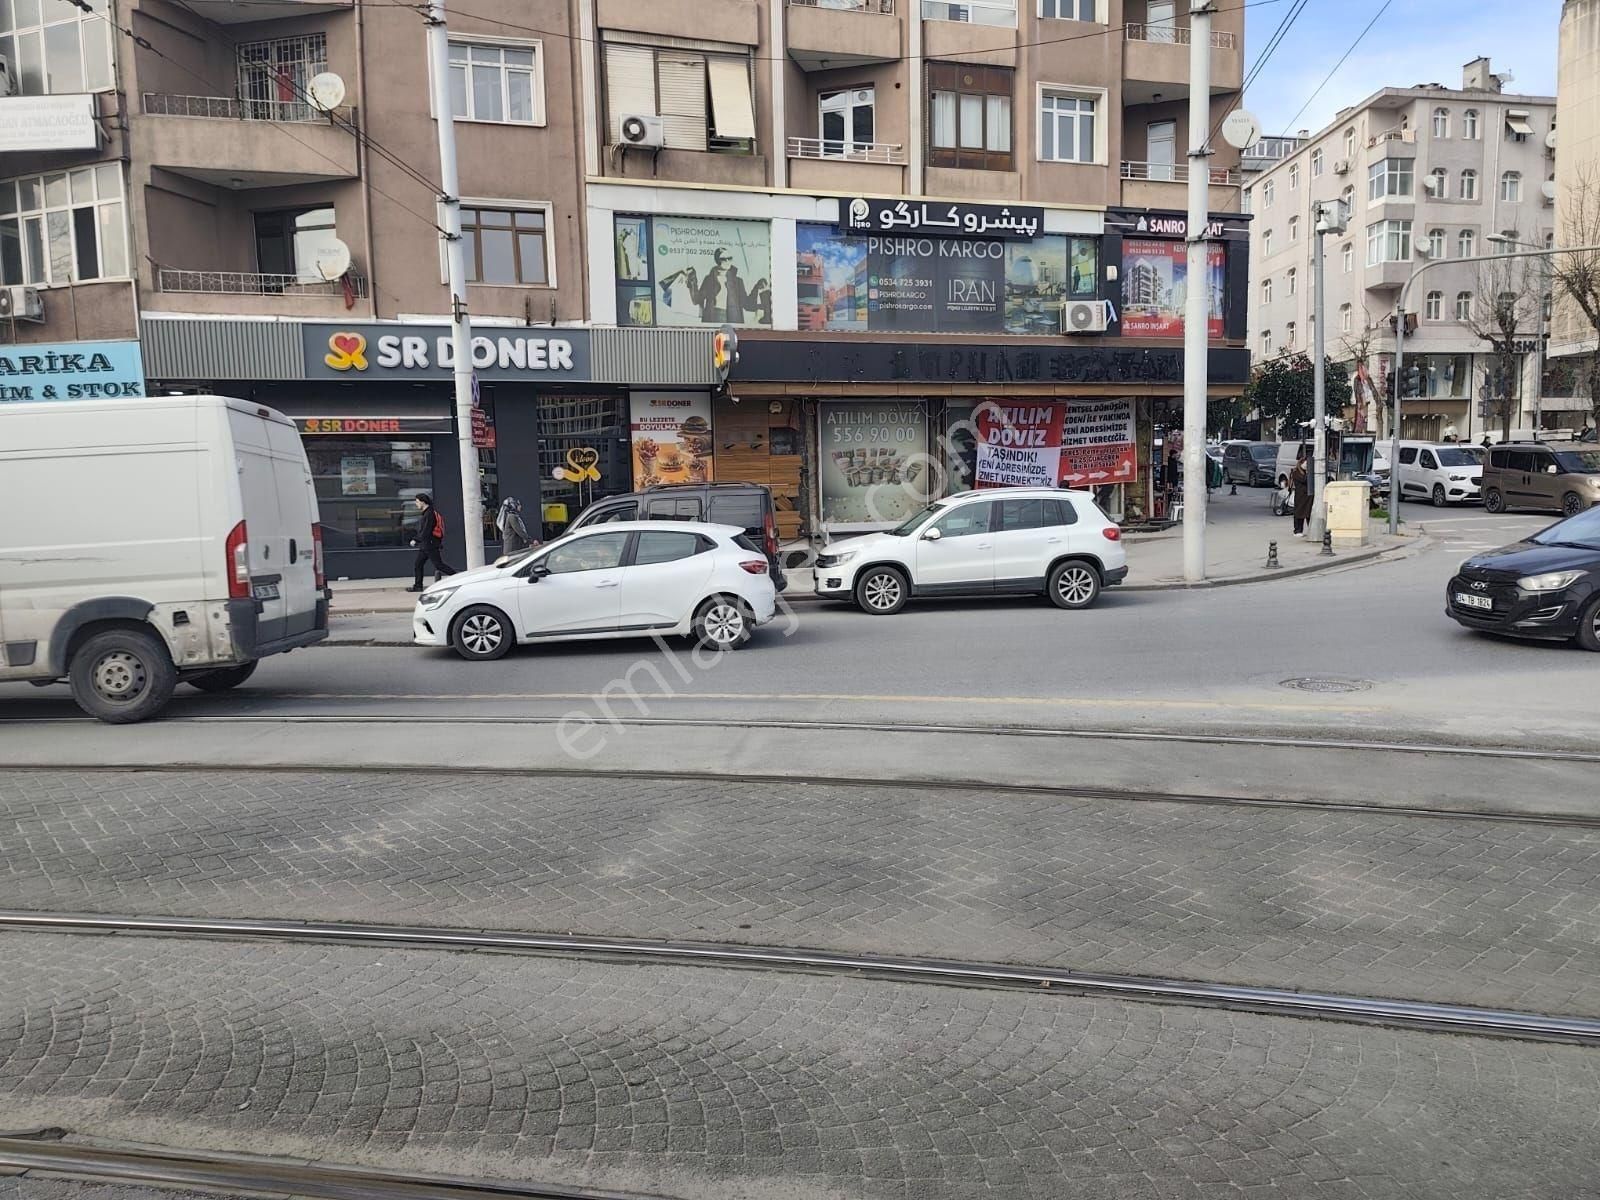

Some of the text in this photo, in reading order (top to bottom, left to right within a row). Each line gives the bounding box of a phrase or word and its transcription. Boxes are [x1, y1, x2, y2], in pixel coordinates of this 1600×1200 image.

[879, 201, 1038, 237] پیشرو کارگو
[1150, 218, 1186, 234] SANRO
[868, 237, 1004, 259] PISHRO KARGO
[948, 279, 995, 303] IRAN
[377, 335, 430, 369] SR
[437, 336, 574, 370] DÖNER
[42, 384, 58, 399] &
[67, 381, 141, 398] STOK
[827, 408, 921, 425] ATILIM DÖVİZ
[987, 406, 1054, 425] ATILIM
[1099, 412, 1131, 422] YAKINDA
[322, 420, 343, 432] SR
[833, 427, 915, 442] 556 90 00
[987, 424, 1047, 446] DÖVİZ
[987, 446, 1038, 463] TAŞINDIK!
